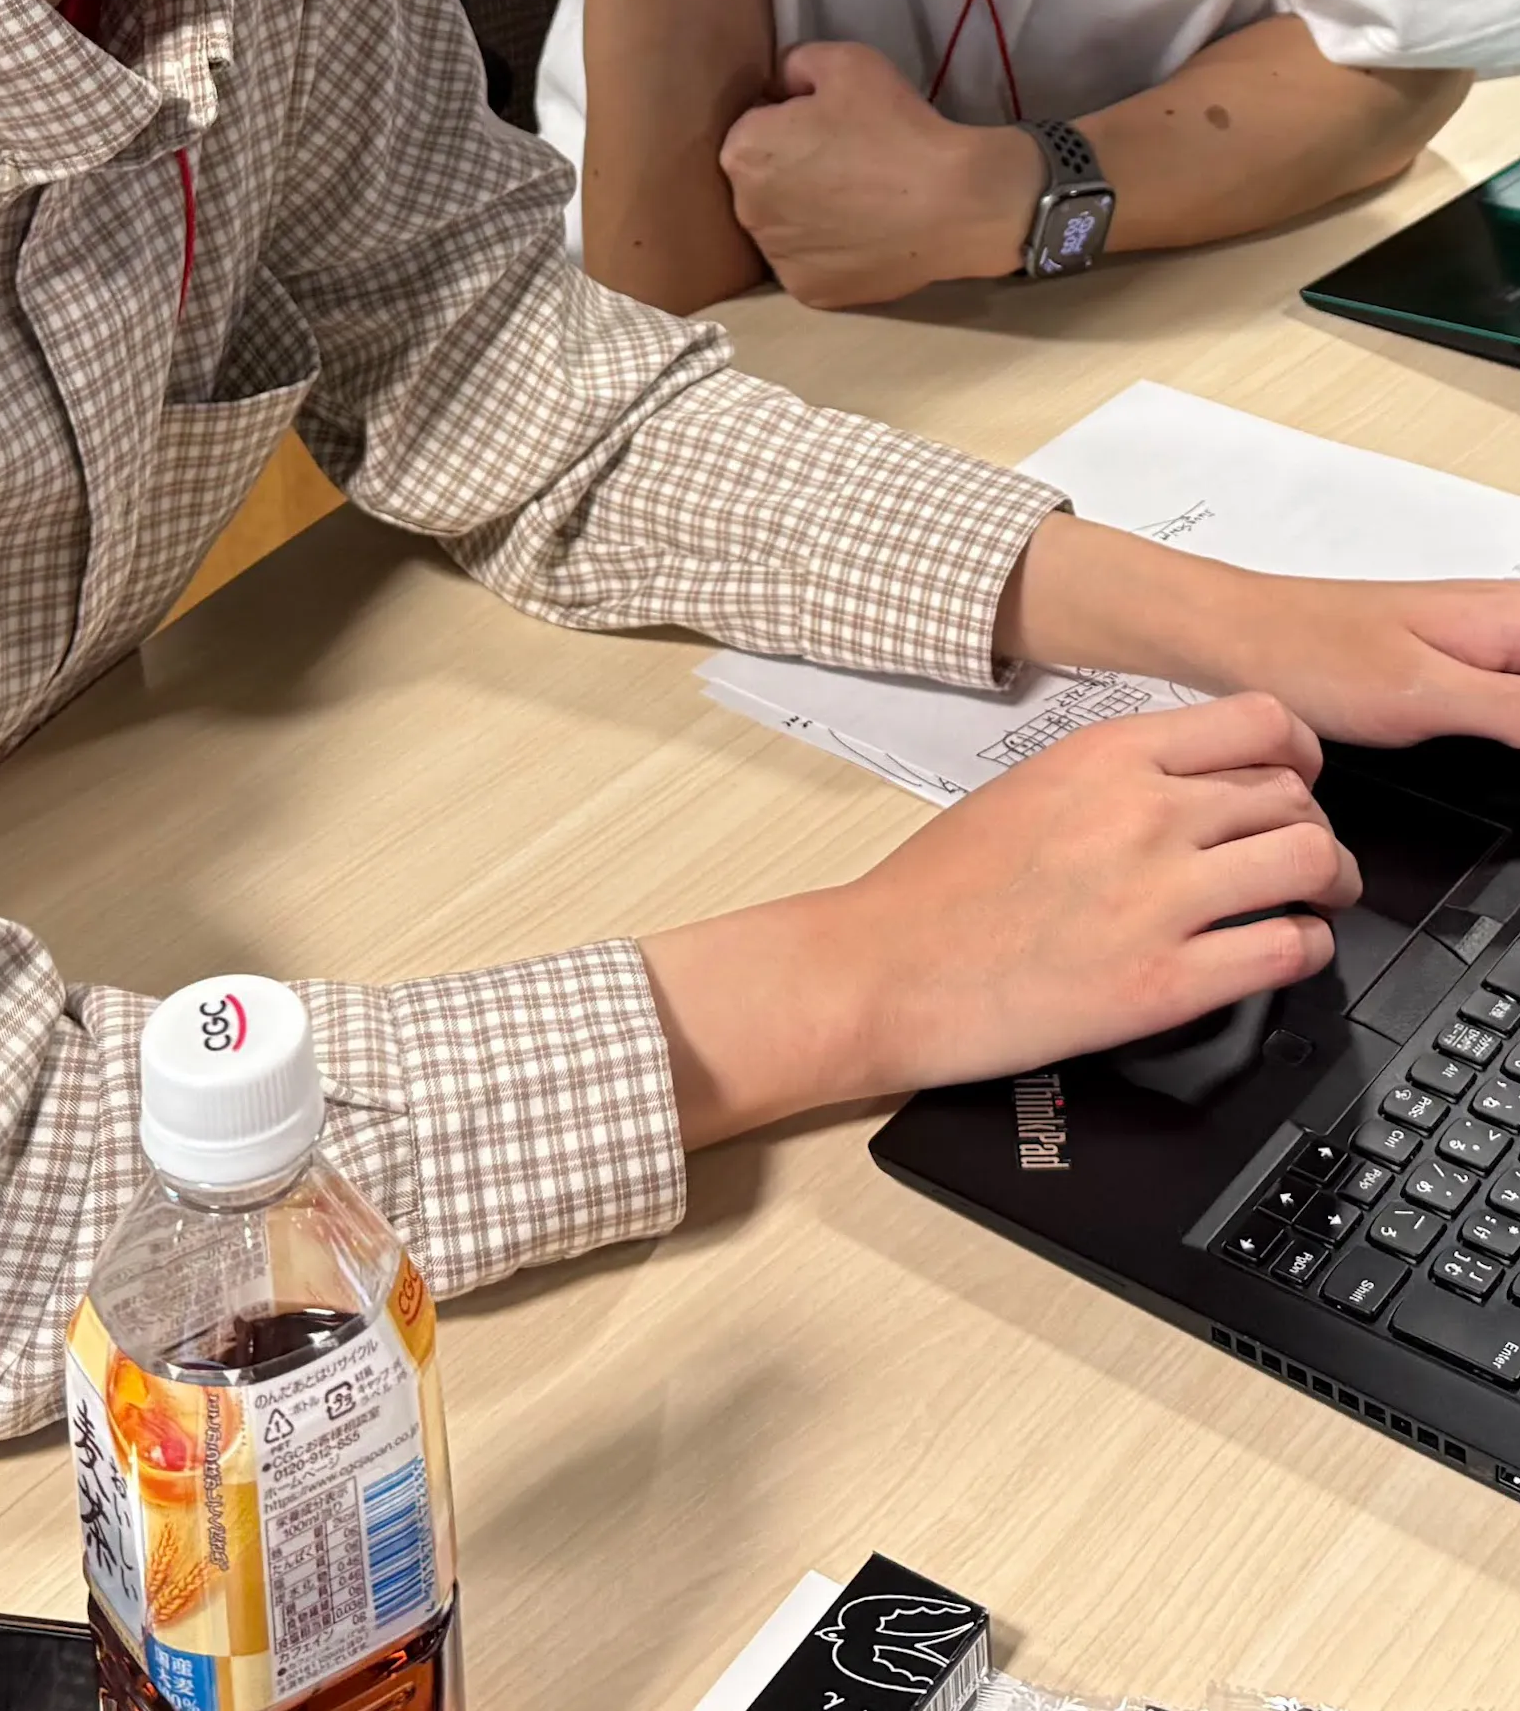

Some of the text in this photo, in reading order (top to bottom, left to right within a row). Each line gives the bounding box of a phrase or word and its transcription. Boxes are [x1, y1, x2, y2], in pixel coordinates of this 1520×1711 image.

[199, 1000, 231, 1051] CGC
[1441, 1062, 1459, 1079] Alt
[1013, 1072, 1071, 1170] ThinkPad
[1408, 1095, 1432, 1118] PrtSc
[1383, 1130, 1405, 1149] Ctrl
[1358, 1167, 1383, 1191] PgUp
[1289, 1251, 1314, 1275] PgDn
[1348, 1279, 1375, 1305] Shift
[1492, 1341, 1520, 1370] Enter
[255, 1340, 378, 1409] のんだあとはリサイクル
[273, 1432, 361, 1482] 0120-912-855
[264, 1454, 339, 1500] ホームページ
[279, 1629, 334, 1664] カフェイン
